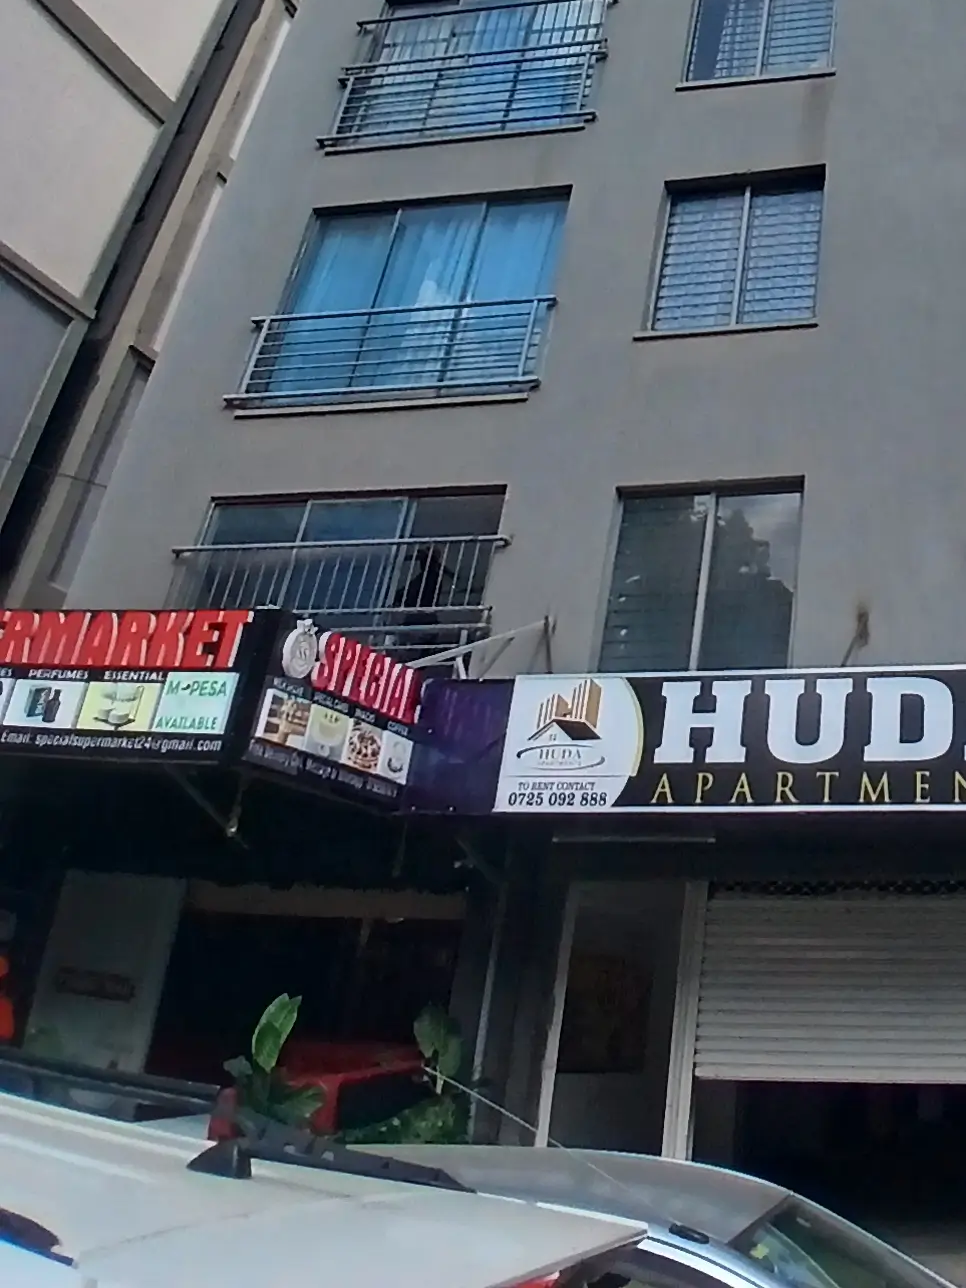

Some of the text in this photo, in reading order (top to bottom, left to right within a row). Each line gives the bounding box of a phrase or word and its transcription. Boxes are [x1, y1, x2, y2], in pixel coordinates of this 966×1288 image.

[0, 608, 254, 668] RMARKET
[28, 668, 88, 680] PERFUMES
[104, 669, 164, 681] ESSENTIAL
[311, 631, 420, 724] SPECIAL
[155, 716, 218, 731] AVAILABLE
[518, 781, 597, 791] TO RENT CONTACT
[508, 791, 608, 807] 0725 092 888
